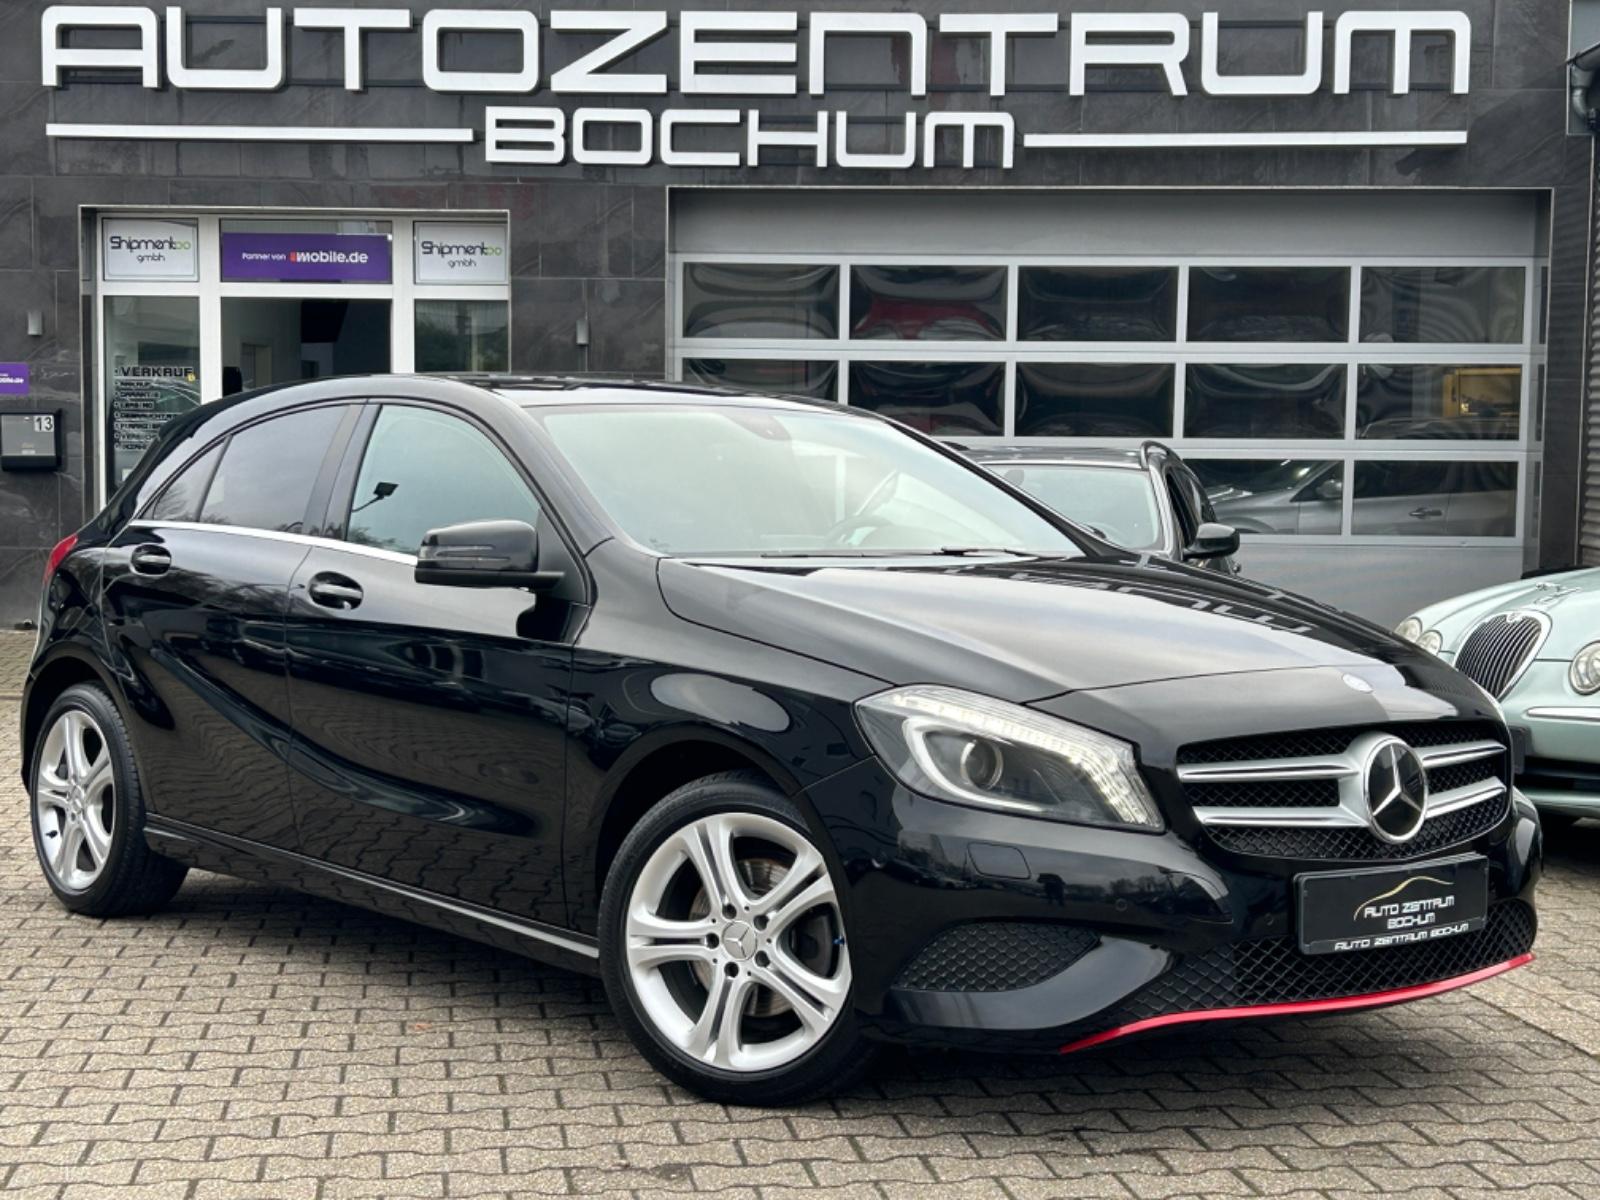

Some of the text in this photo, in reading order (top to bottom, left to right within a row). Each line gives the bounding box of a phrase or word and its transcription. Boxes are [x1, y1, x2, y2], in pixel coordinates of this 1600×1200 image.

[41, 5, 1472, 97] AUTOZENTRUM
[484, 105, 1014, 169] BOCHUM
[242, 252, 270, 260] Partner
[121, 366, 193, 377] VERKAUF
[36, 416, 53, 431] 13
[1364, 895, 1455, 919] AUTO ZENTRUM
[1387, 912, 1436, 930] BOCHUM
[1334, 923, 1469, 951] AUTO ZENTRUM BOCHUM
